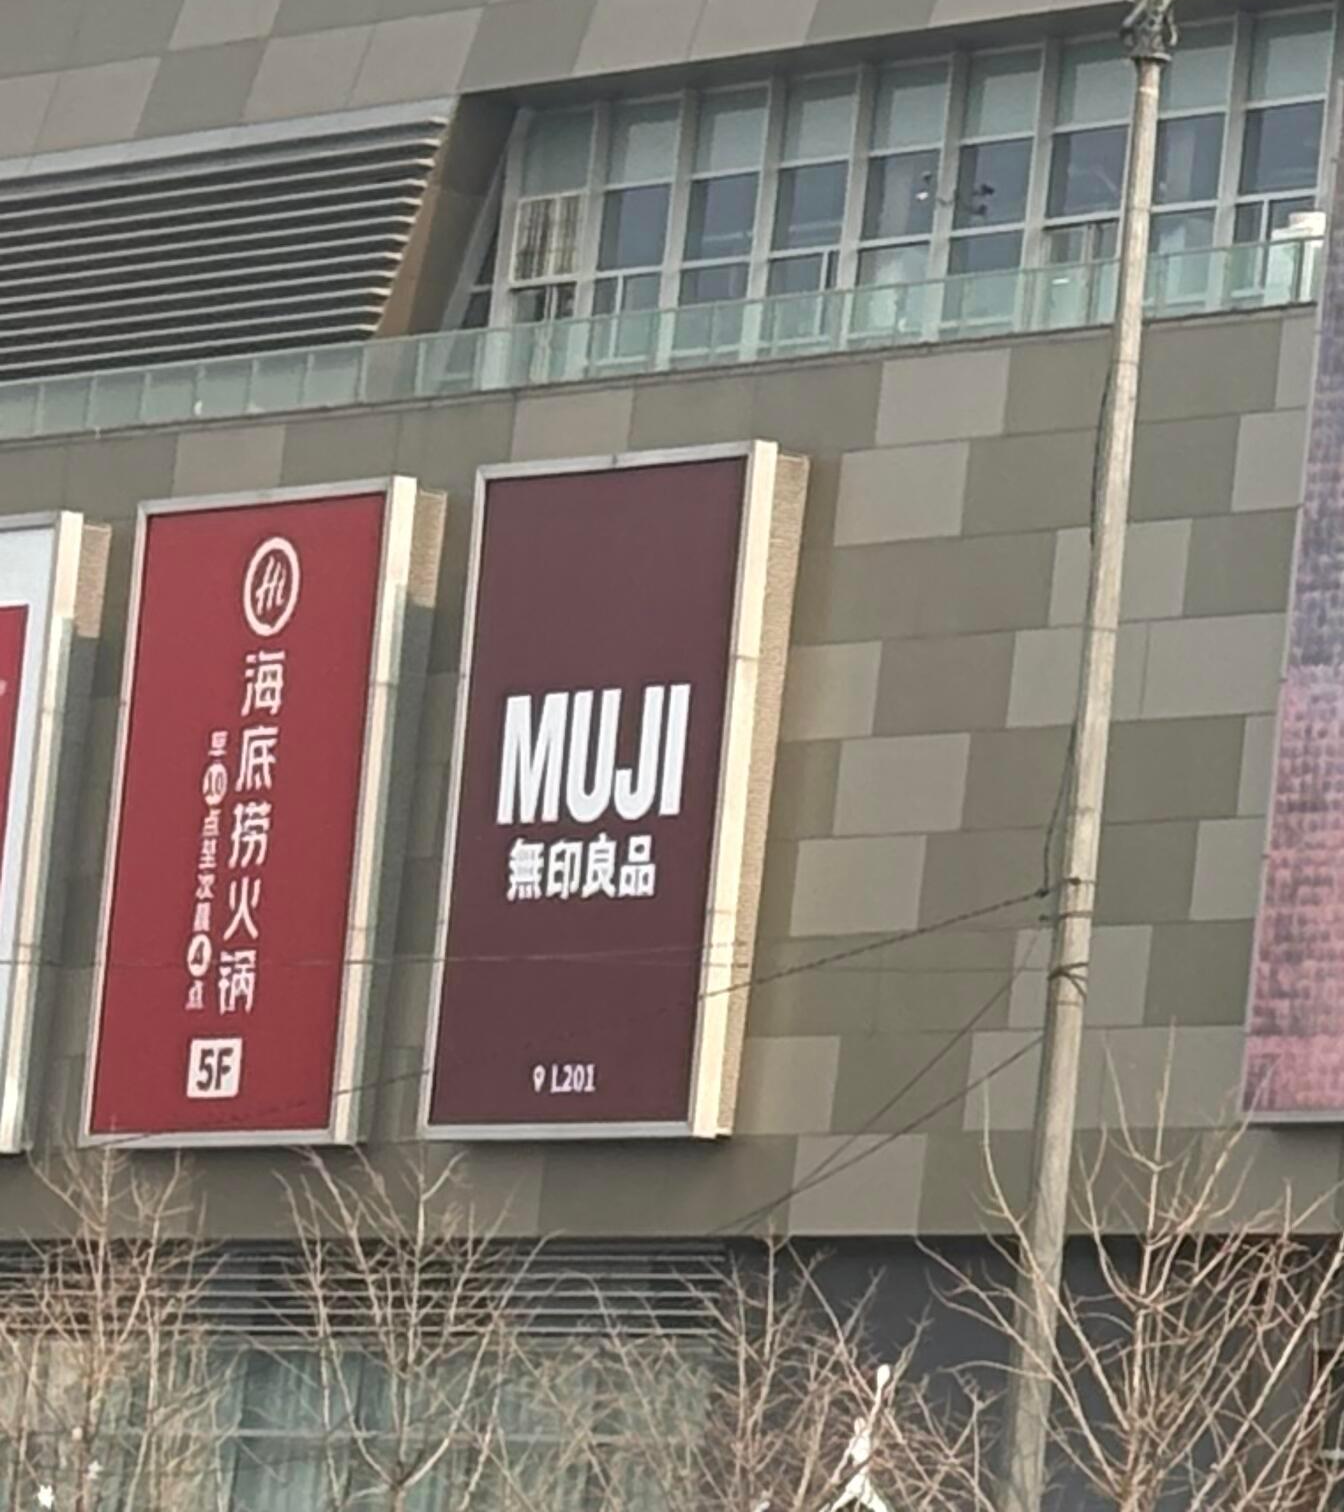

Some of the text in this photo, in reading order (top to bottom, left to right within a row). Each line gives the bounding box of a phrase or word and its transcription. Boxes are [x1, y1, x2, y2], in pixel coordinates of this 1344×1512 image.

[496, 683, 691, 825] MUJI
[217, 649, 286, 1016] 海底捞火锅
[506, 833, 657, 900] 無印良品
[196, 1047, 234, 1092] 5F
[550, 1064, 596, 1093] L201
